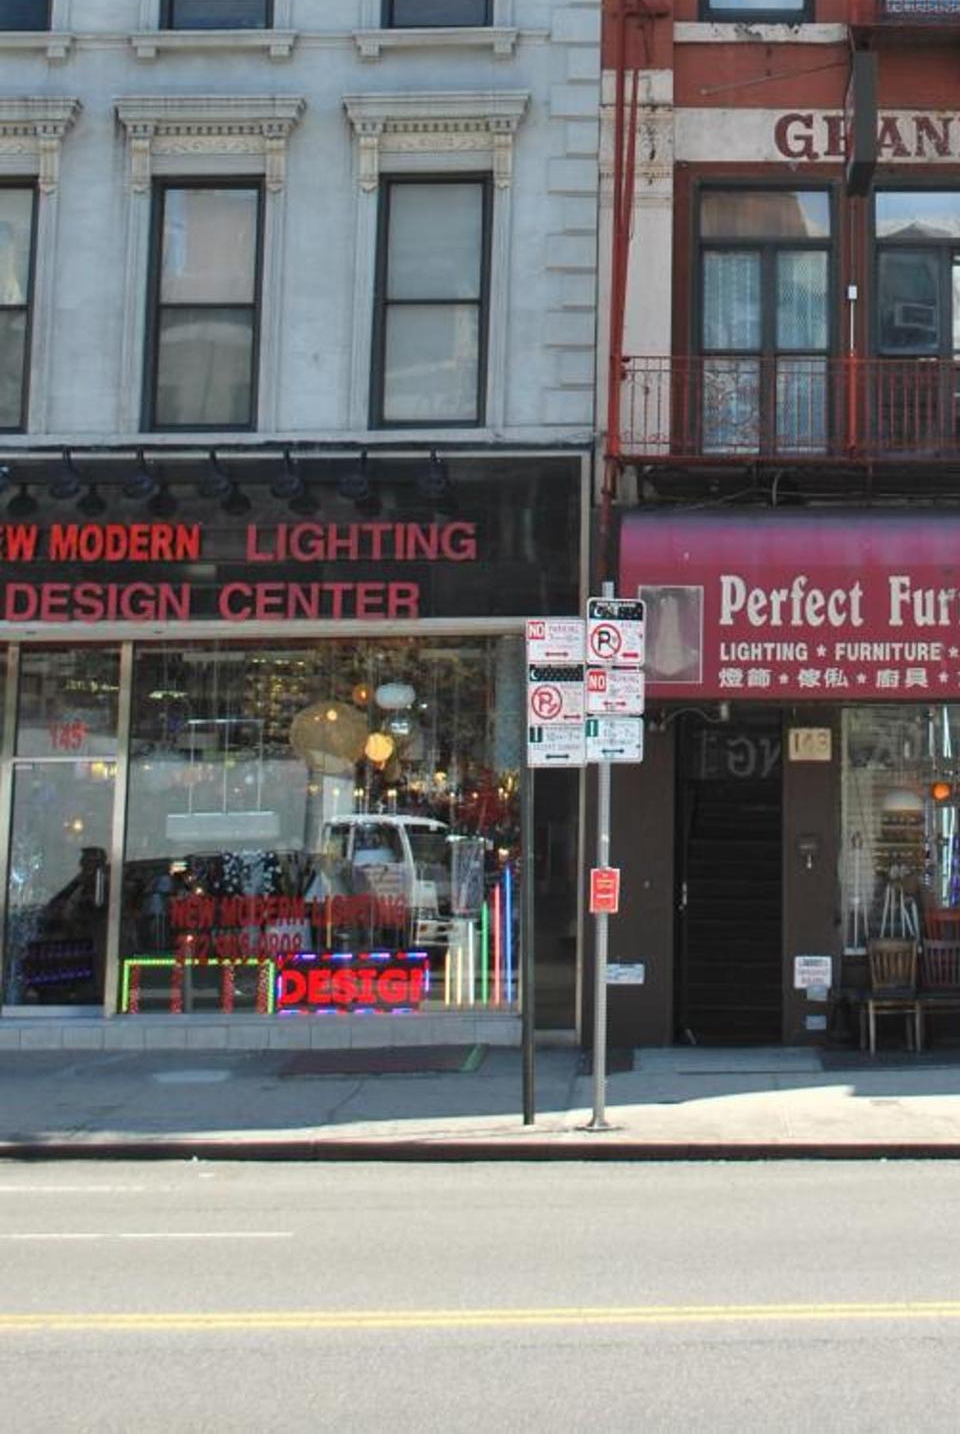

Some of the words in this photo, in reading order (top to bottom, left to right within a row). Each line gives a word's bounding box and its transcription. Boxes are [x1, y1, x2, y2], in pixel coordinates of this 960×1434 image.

[0, 523, 38, 562] W
[50, 521, 202, 562] MODERN
[246, 522, 478, 562] LIGHTING
[5, 581, 192, 623] DESIGN
[218, 582, 422, 623] CENTER
[719, 574, 865, 627] Perfect
[528, 623, 545, 639] NO
[719, 642, 809, 662] LIGHTING
[835, 642, 943, 662] FURNITURE
[588, 673, 606, 691] NO
